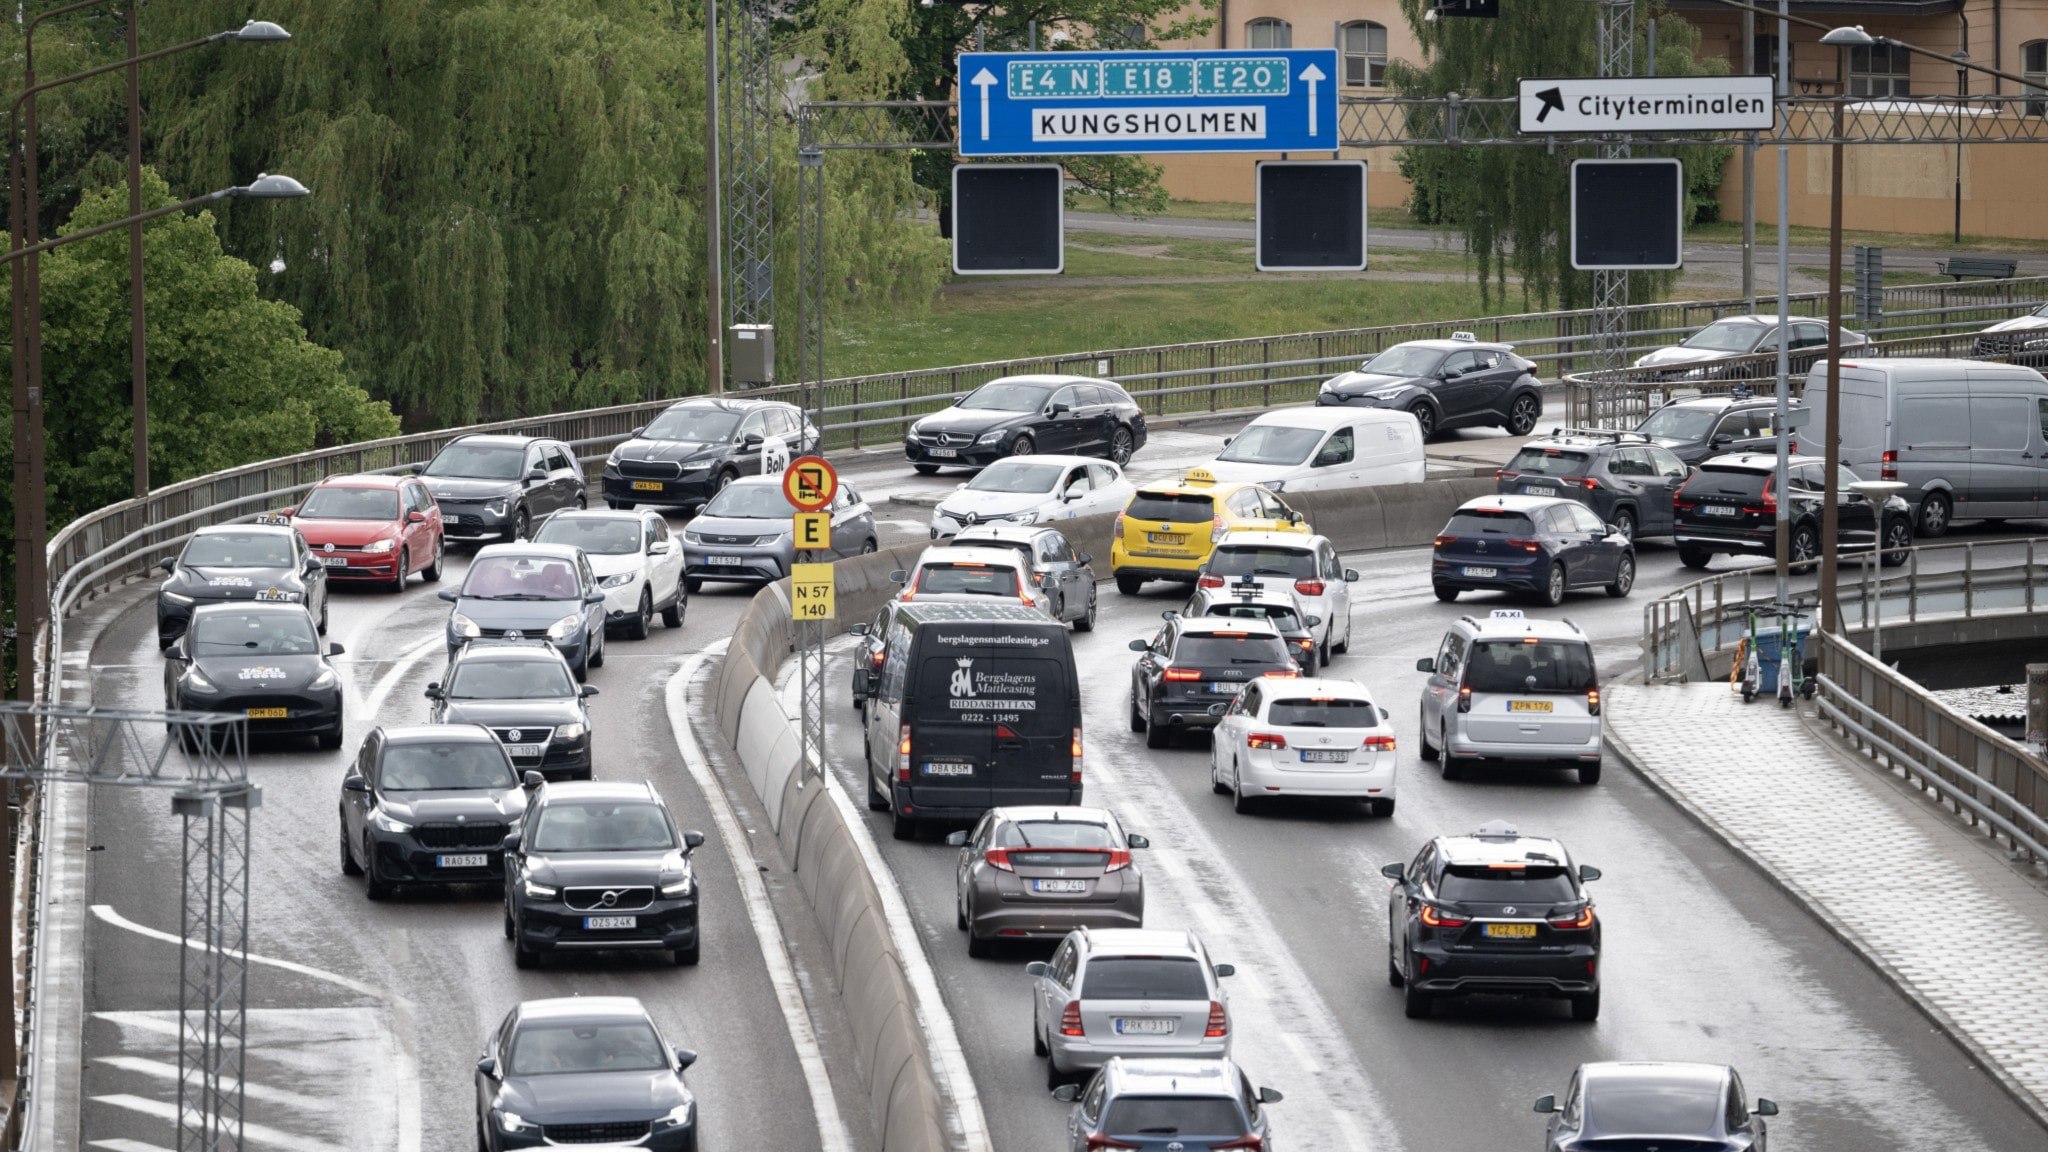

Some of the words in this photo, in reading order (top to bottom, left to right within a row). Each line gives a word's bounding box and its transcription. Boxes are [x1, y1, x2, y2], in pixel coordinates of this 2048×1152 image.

[1021, 68, 1056, 90] E4
[1071, 68, 1088, 90] N
[1125, 67, 1173, 89] E18
[1213, 65, 1272, 88] E20
[1578, 93, 1765, 120] Cityterminalen
[1041, 112, 1258, 135] KUNGSHOLMEN
[766, 454, 785, 475] Bolt
[260, 515, 286, 525] TAXI
[805, 518, 819, 543] E
[259, 592, 288, 600] TAXI
[797, 586, 807, 599] N
[813, 586, 829, 598] 57
[801, 604, 827, 616] 140
[938, 634, 1050, 647] bergslagensmattleasing.se
[975, 671, 1036, 685] Bergslagens
[975, 683, 1036, 696] Mattleasing
[951, 700, 1036, 709] RIDDARHYTTAN
[1514, 701, 1532, 711] ZPN
[1534, 702, 1550, 711] 176
[961, 713, 984, 722] 0222
[992, 713, 1020, 723] 13495
[520, 746, 537, 756] 102
[1329, 751, 1347, 761] 535
[931, 763, 949, 773] DBA
[951, 763, 969, 773] 85M
[465, 856, 483, 865] 521
[1064, 880, 1084, 890] 740
[613, 917, 632, 928] 24K
[1490, 924, 1511, 936] YCZ
[1513, 924, 1533, 936] 167
[1123, 1020, 1143, 1031] PRK
[1151, 1020, 1170, 1031] 311
